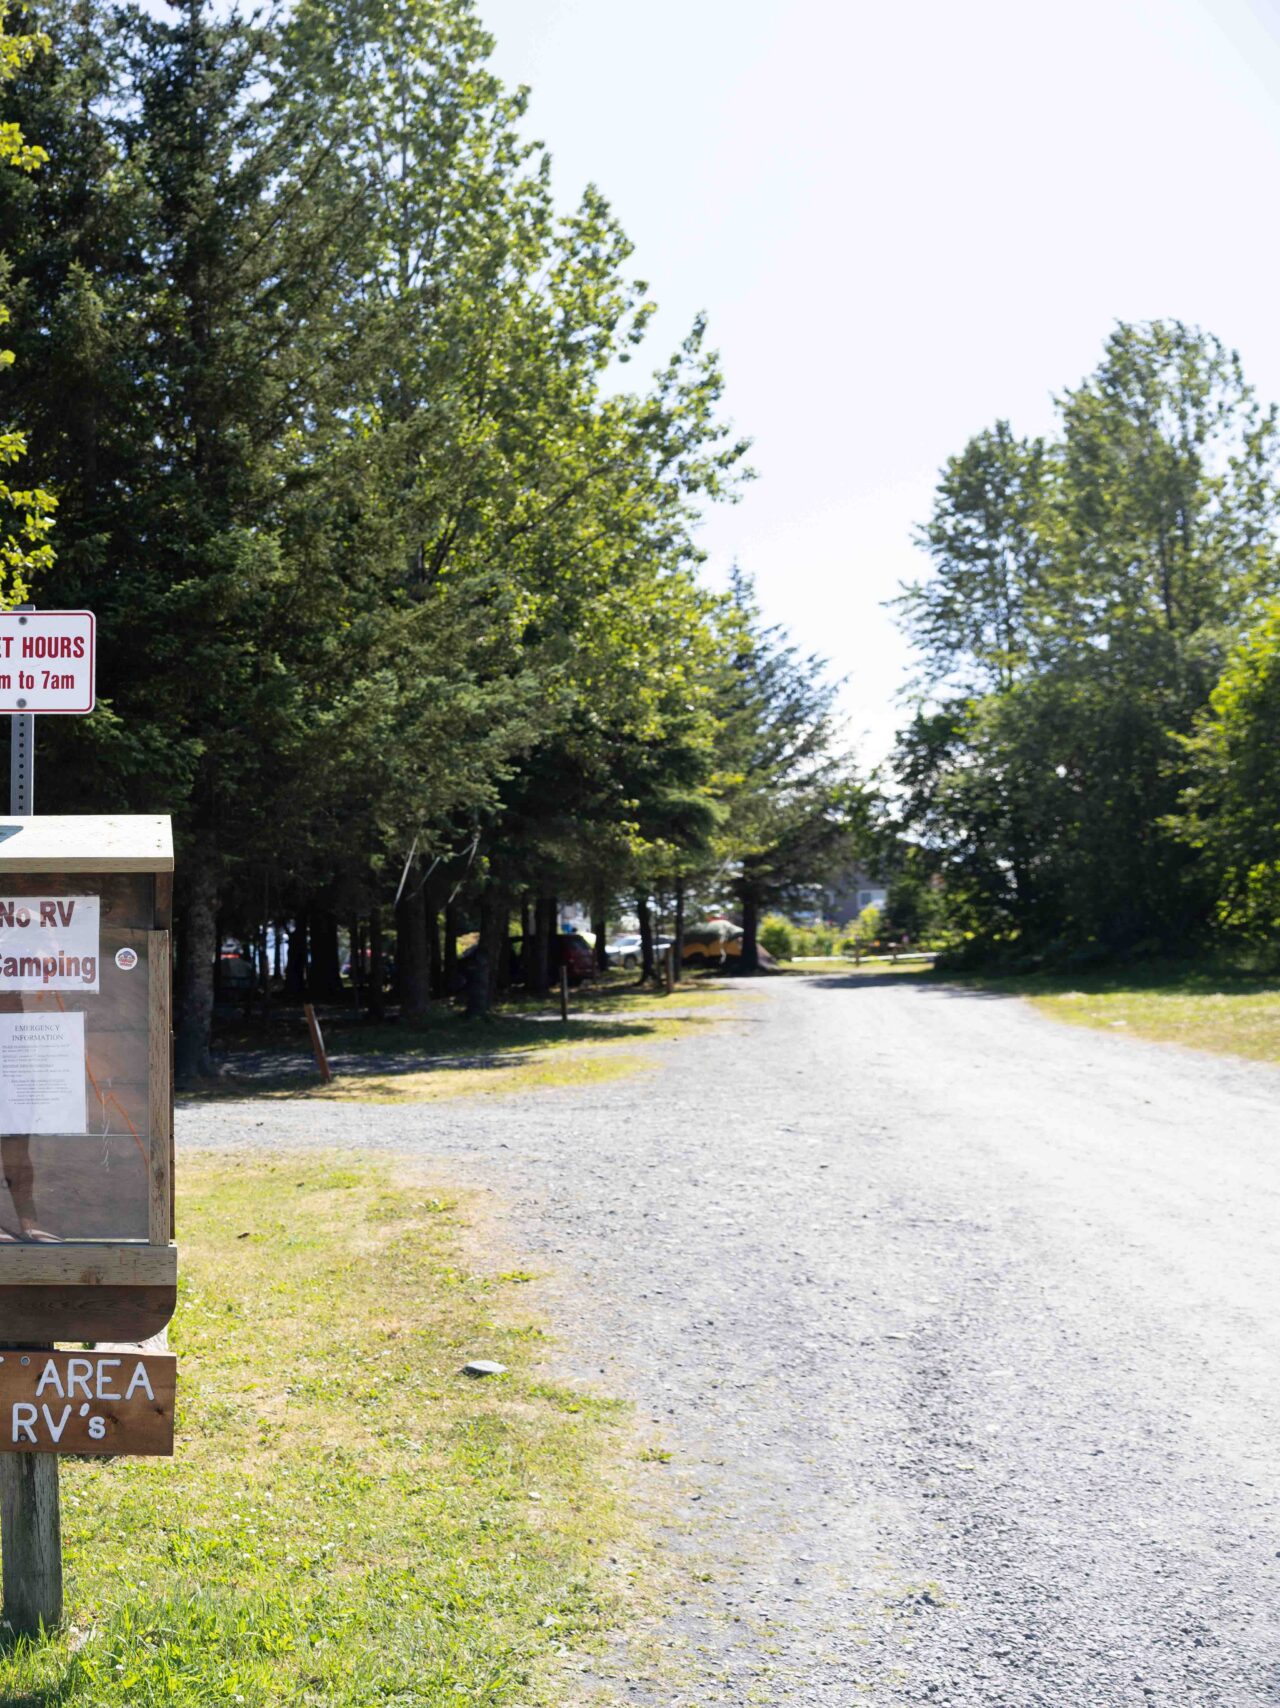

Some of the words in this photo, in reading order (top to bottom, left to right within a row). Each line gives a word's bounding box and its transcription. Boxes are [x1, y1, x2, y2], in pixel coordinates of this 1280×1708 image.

[22, 636, 85, 658] HOURS
[18, 670, 35, 689] to
[41, 671, 75, 689] 7am
[39, 900, 75, 928] RV
[36, 1358, 155, 1400] AREA
[11, 1403, 106, 1443] RV's
